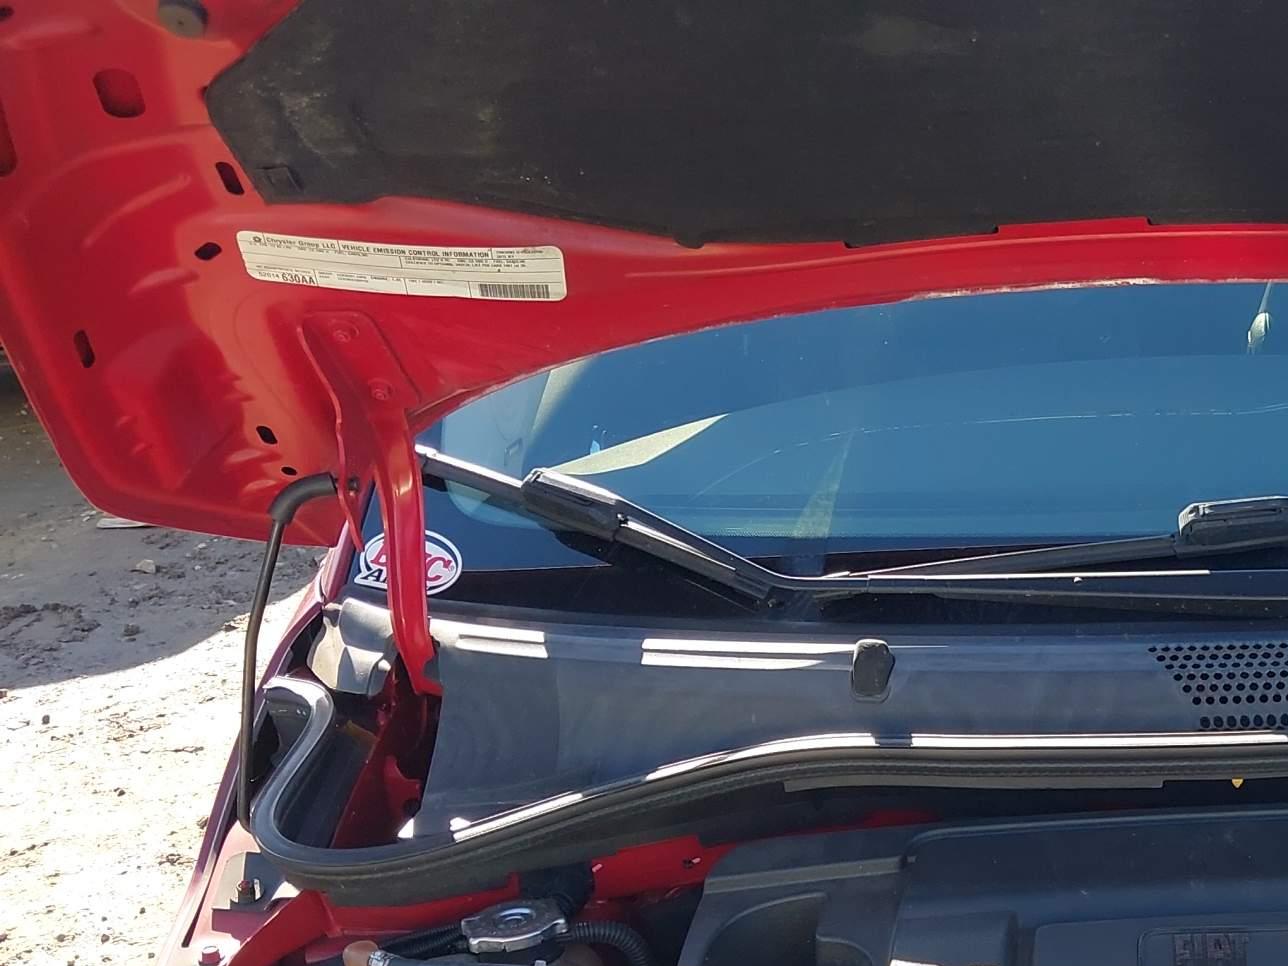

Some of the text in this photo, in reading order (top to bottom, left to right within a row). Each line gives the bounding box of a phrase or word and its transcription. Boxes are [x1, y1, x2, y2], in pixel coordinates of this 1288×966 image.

[266, 237, 297, 248] Chrysler
[299, 240, 320, 249] Group
[341, 244, 371, 253] VEHICLE
[373, 247, 406, 256] EMISSION
[408, 249, 440, 257] CONTROL
[281, 272, 316, 285] 630AA
